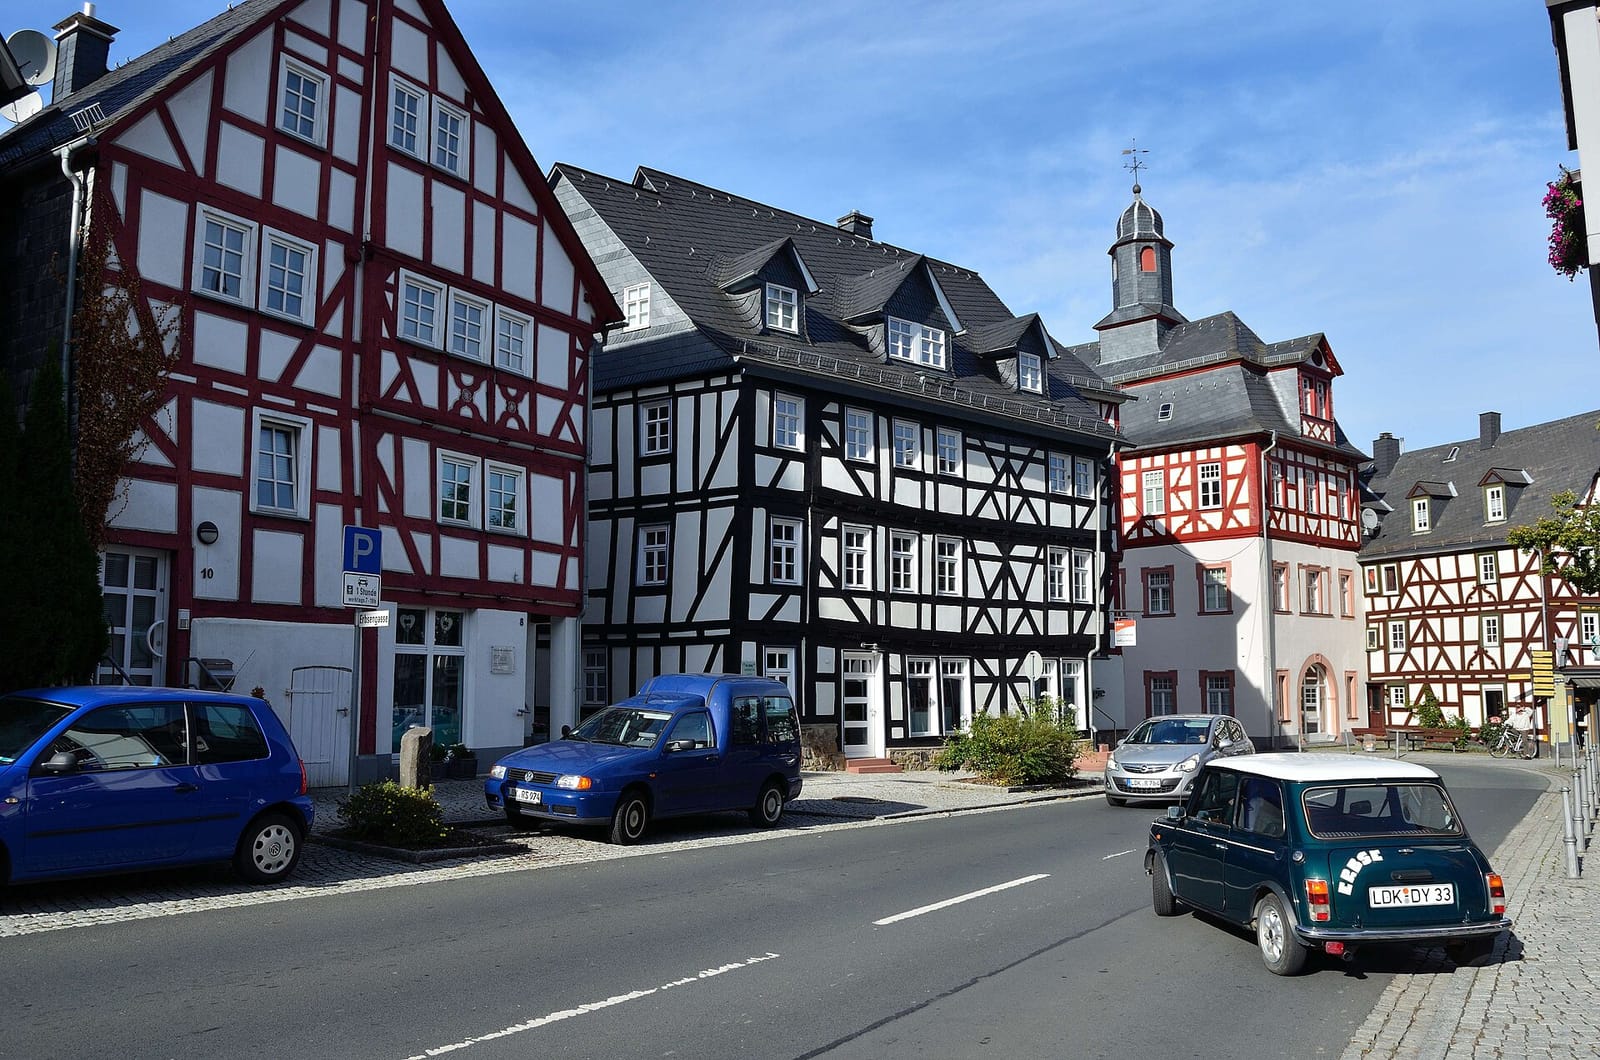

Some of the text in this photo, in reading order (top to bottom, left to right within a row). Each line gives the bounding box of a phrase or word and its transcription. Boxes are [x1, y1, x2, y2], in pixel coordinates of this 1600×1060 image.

[353, 533, 373, 568] P
[201, 568, 213, 579] 10
[360, 587, 377, 597] Stunde
[360, 614, 388, 626] Erbsengasse
[520, 618, 524, 626] 8
[521, 790, 529, 800] RS
[530, 791, 540, 801] 974
[1338, 849, 1384, 896] ERBSE
[1435, 887, 1451, 902] 33
